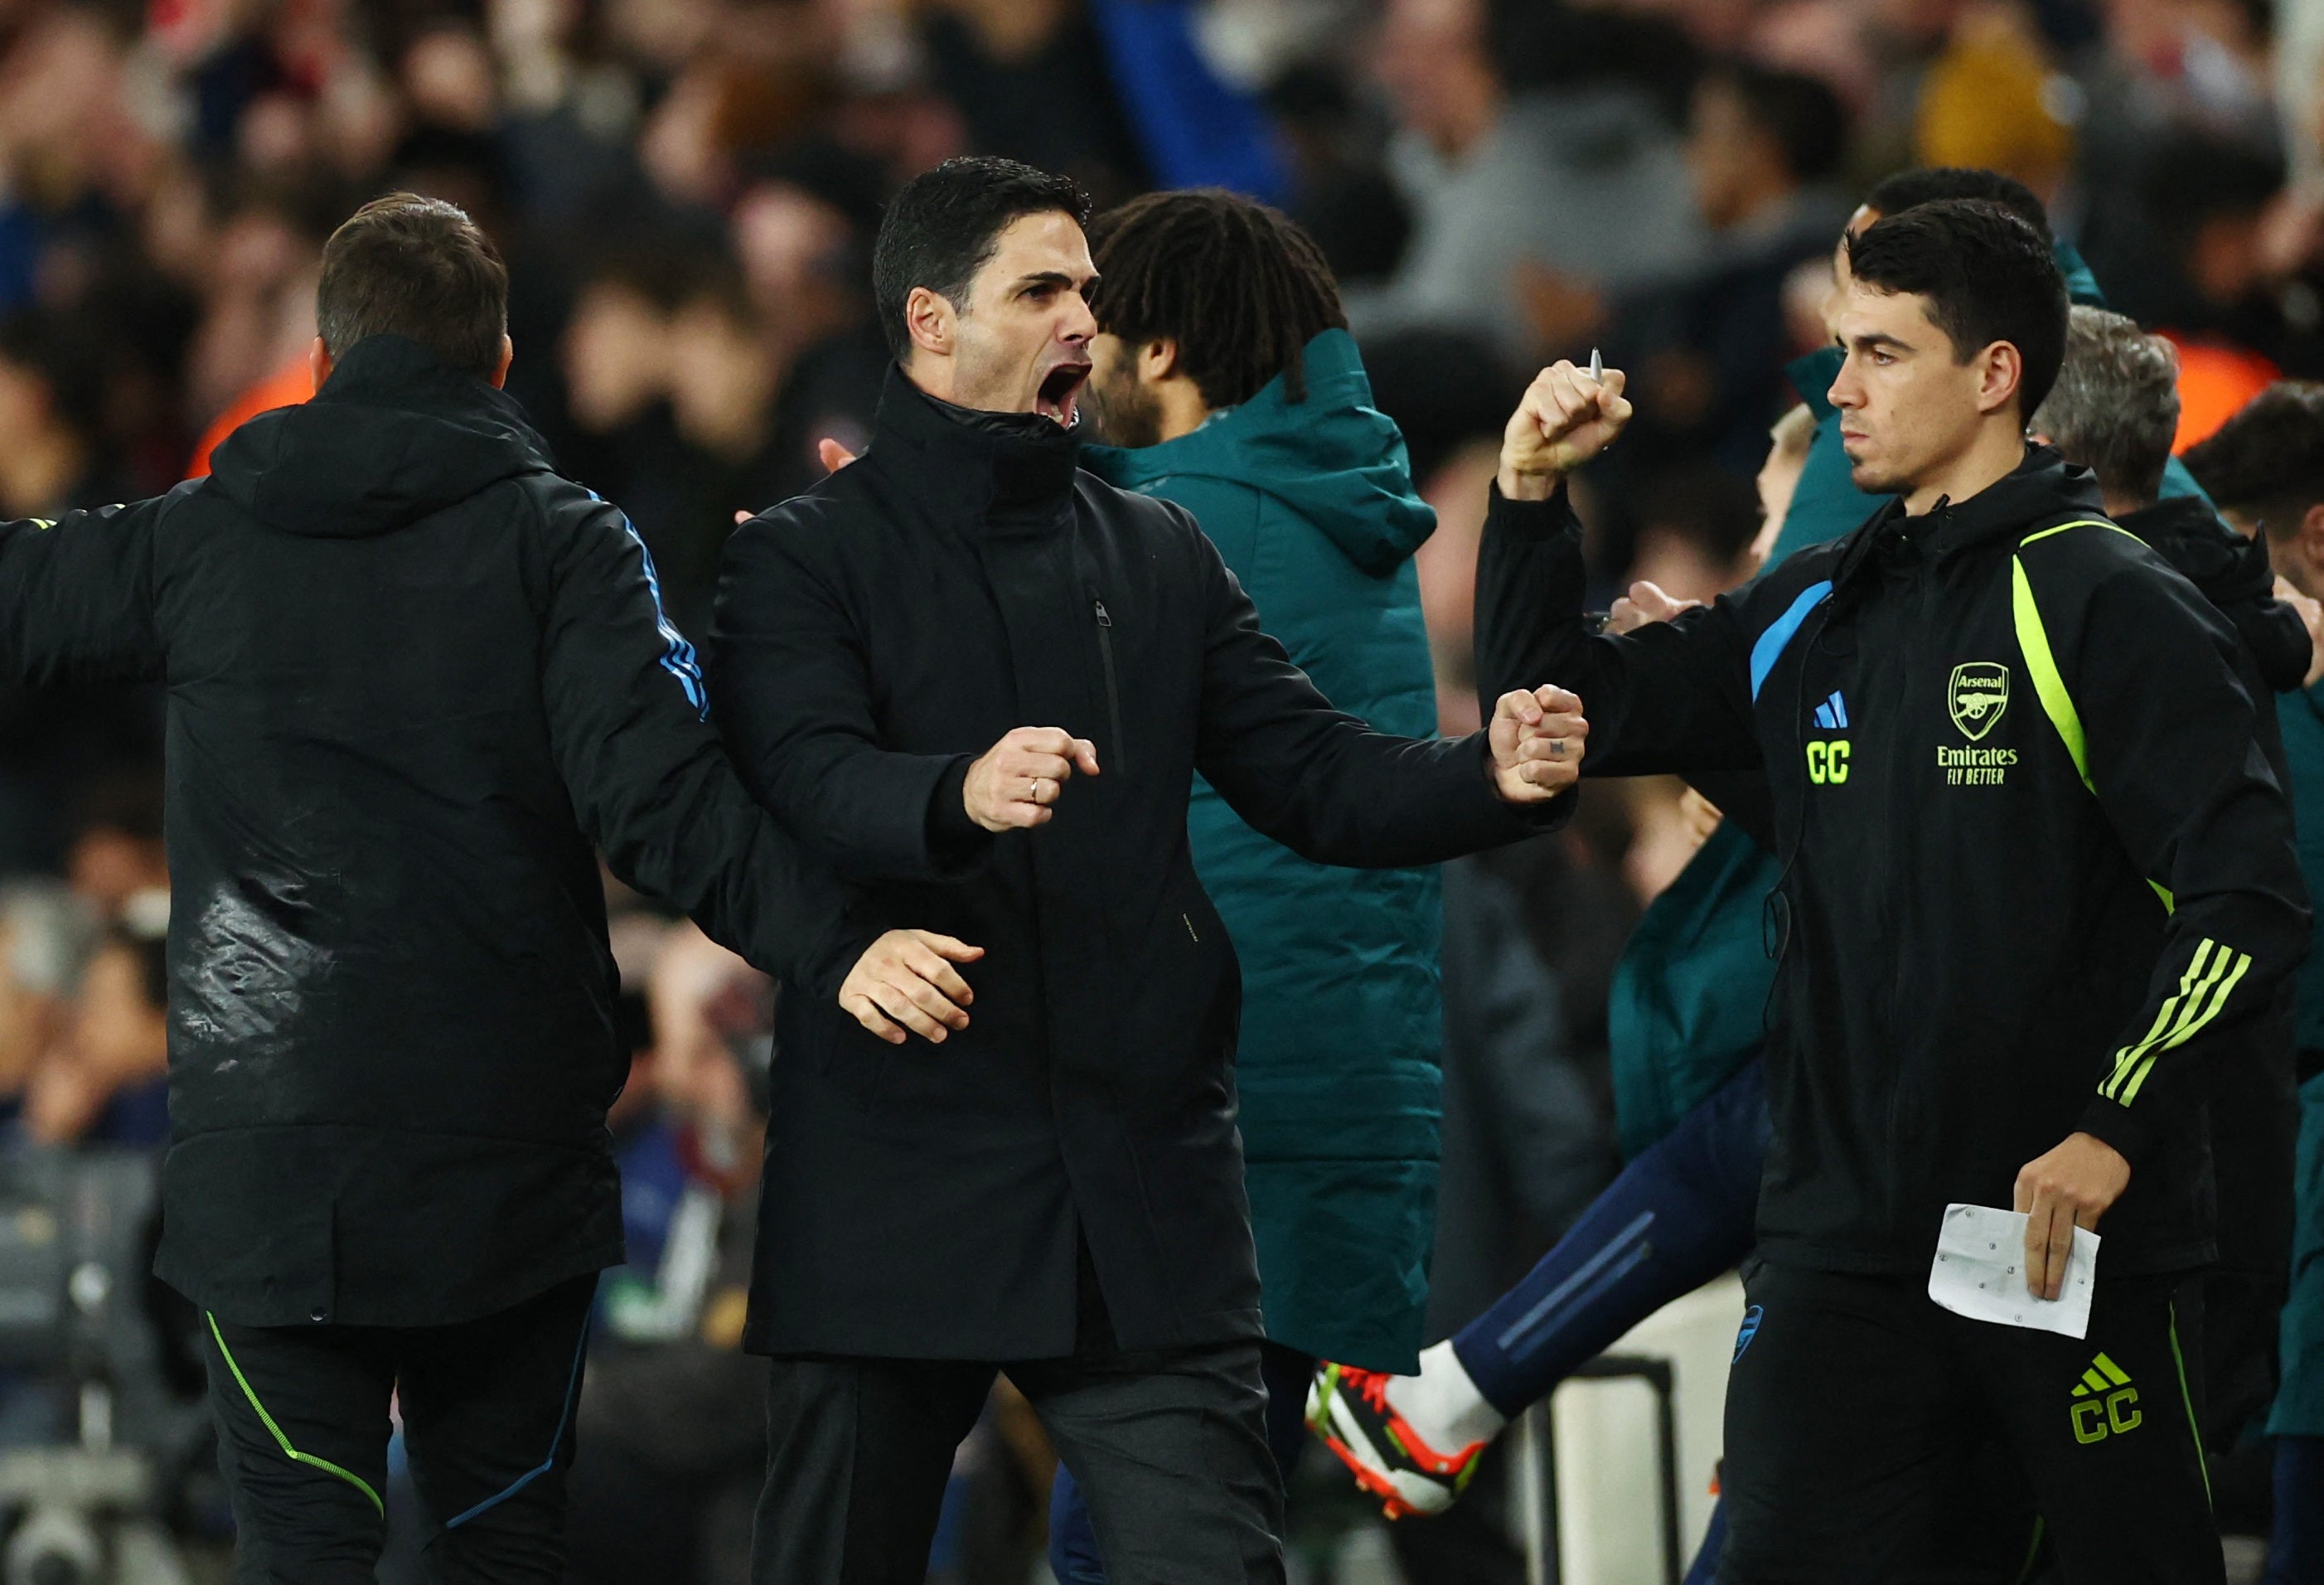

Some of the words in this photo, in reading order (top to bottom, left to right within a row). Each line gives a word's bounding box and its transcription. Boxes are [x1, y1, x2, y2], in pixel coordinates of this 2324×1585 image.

[1958, 675, 2002, 688] Arsenal
[1807, 740, 1851, 784] CC
[1937, 744, 2018, 766] Emirates
[1947, 768, 1963, 785] FLY
[1966, 768, 2004, 785] BETTER
[2070, 1388, 2142, 1444] CC
